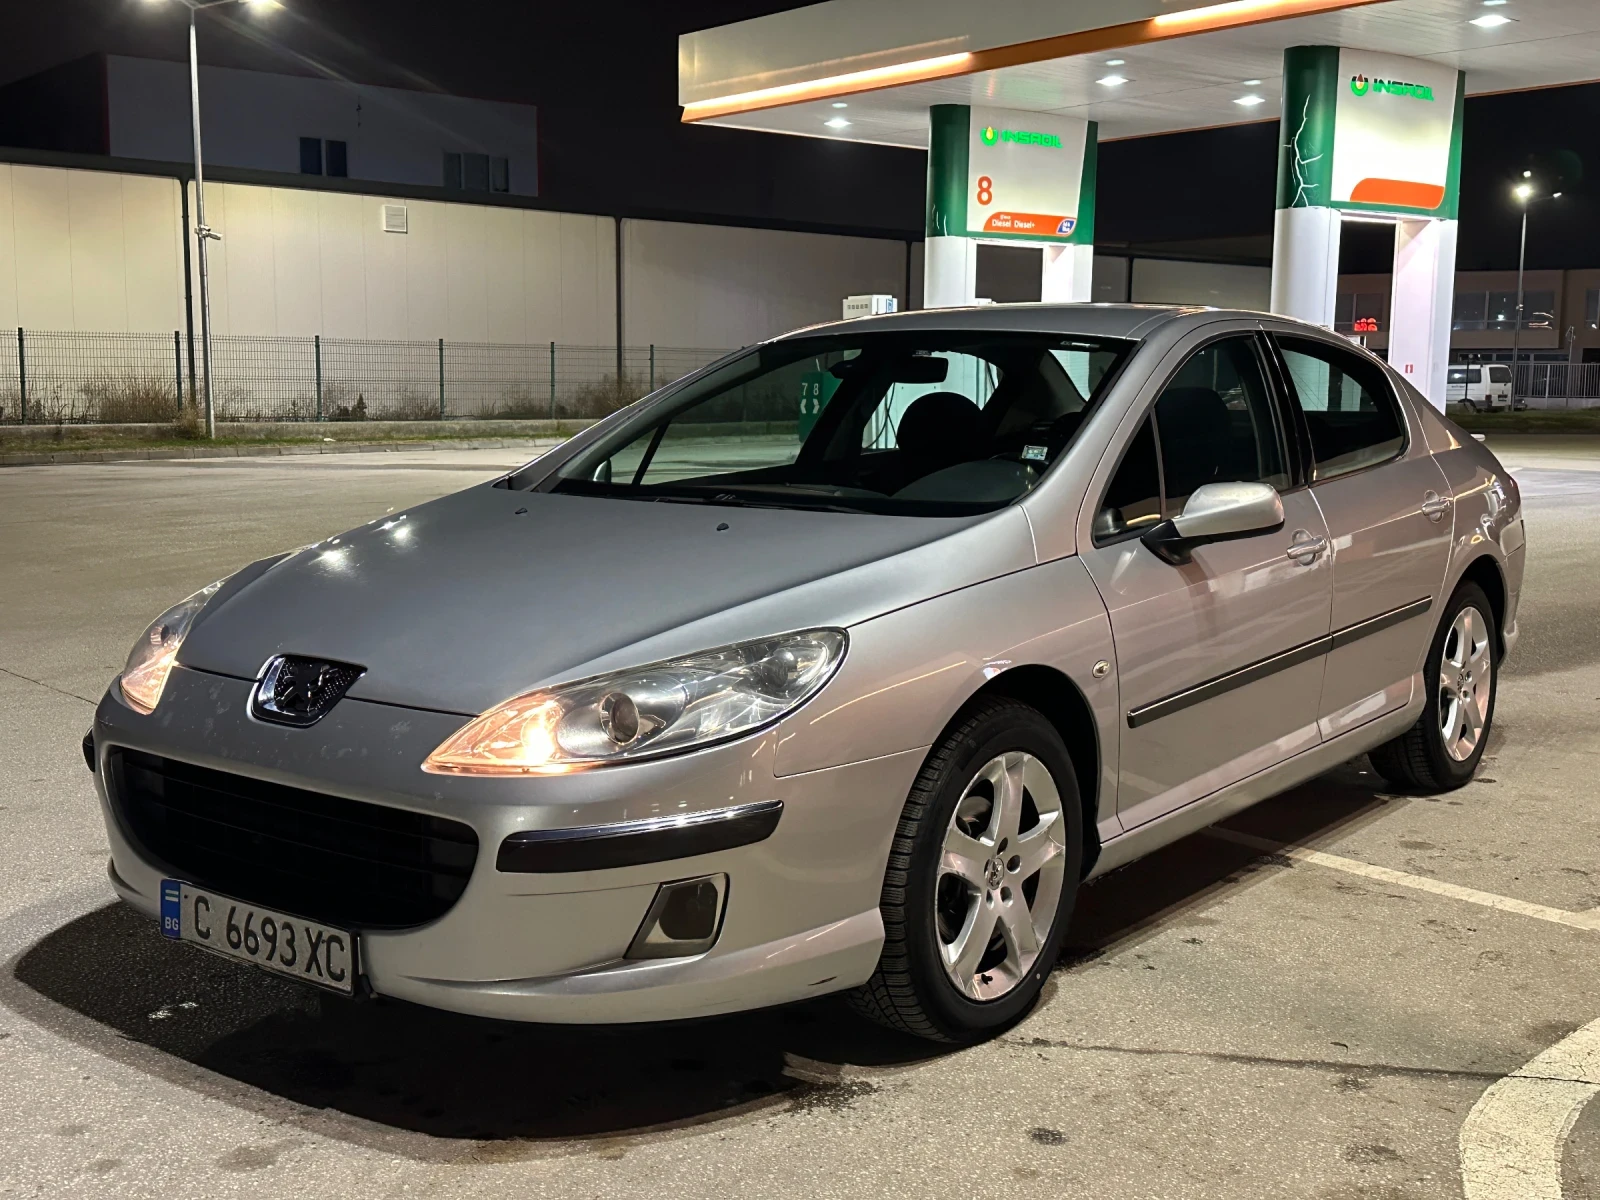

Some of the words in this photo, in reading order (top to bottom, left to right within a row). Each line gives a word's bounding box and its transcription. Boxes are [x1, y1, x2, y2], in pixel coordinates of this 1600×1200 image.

[1373, 78, 1434, 101] INSAOIL
[1001, 130, 1063, 148] INSAOIL
[977, 176, 992, 205] 8
[992, 219, 1011, 228] Diesel
[802, 383, 808, 395] 7
[813, 383, 819, 395] 8
[165, 917, 179, 930] BG
[194, 895, 211, 940] C
[226, 906, 297, 967] 6693
[305, 927, 346, 982] XC
